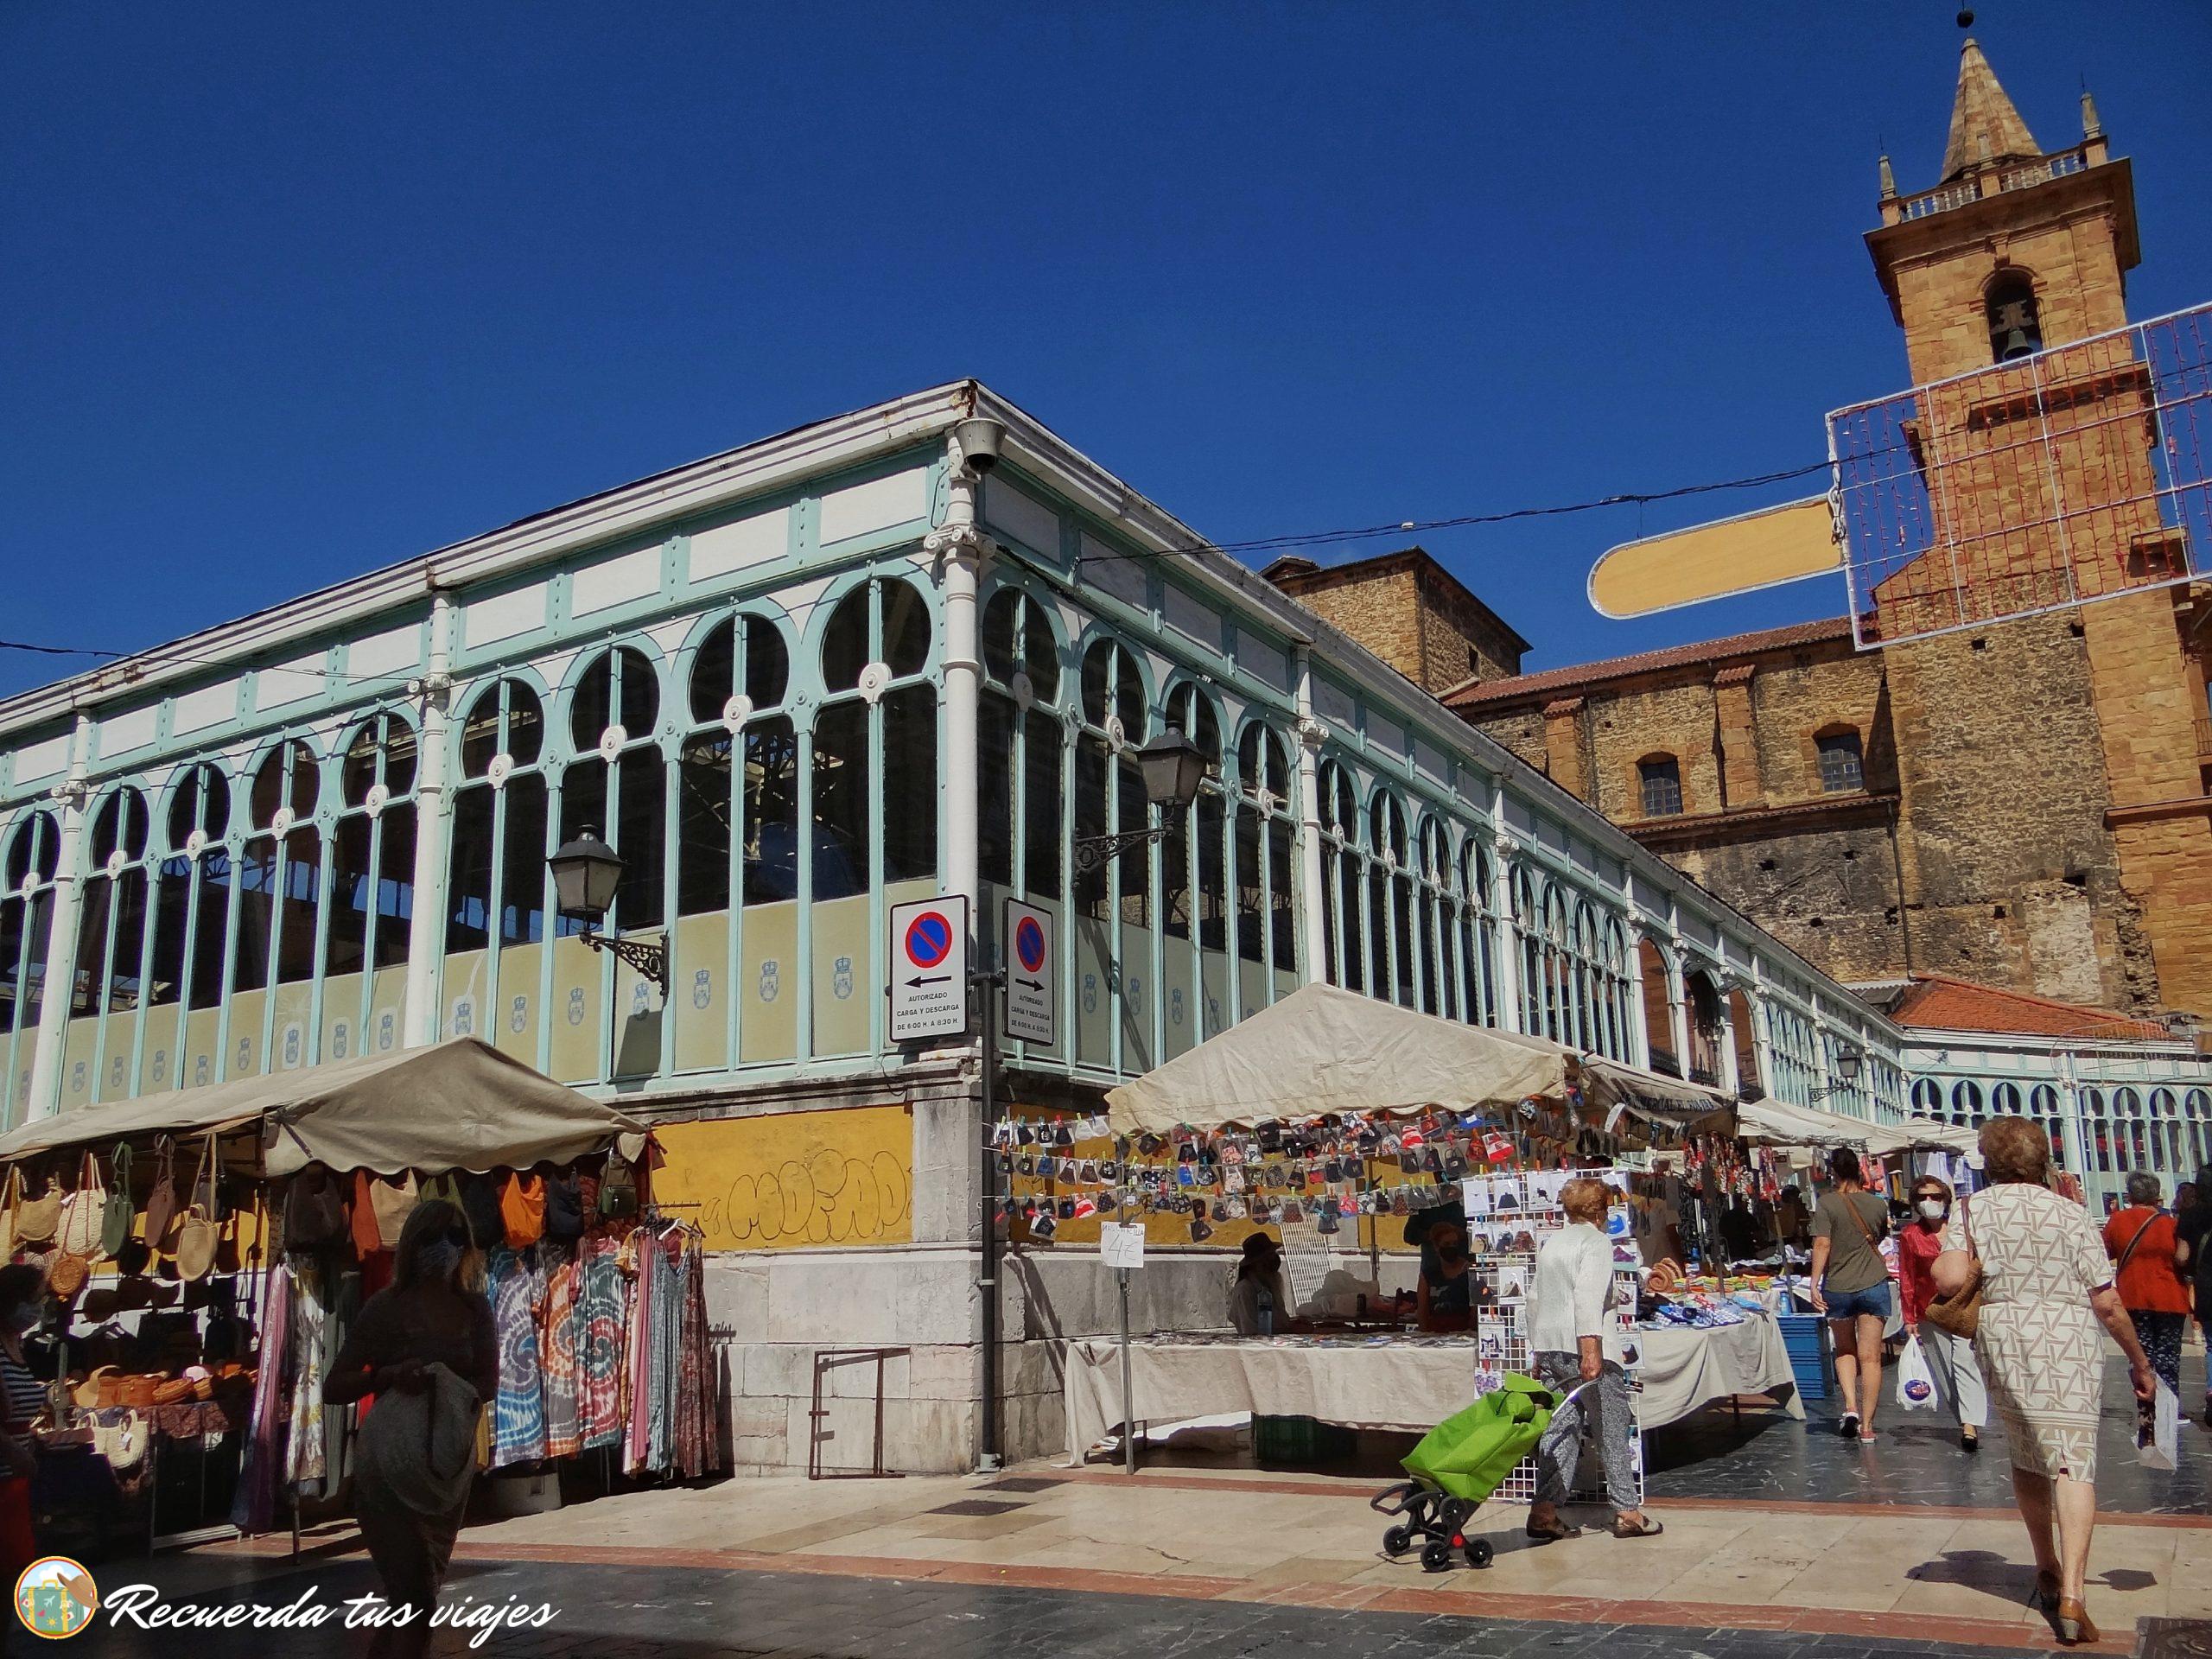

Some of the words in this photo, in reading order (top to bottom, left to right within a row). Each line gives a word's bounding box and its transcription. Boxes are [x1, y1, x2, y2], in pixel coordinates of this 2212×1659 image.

[908, 992, 948, 1002] AUTORIZADO
[1019, 995, 1044, 1007] AUTORIZADO
[925, 1004, 959, 1014] DESCARGA
[1011, 1006, 1025, 1015] CARGA
[1029, 1010, 1050, 1021] DESCARGA
